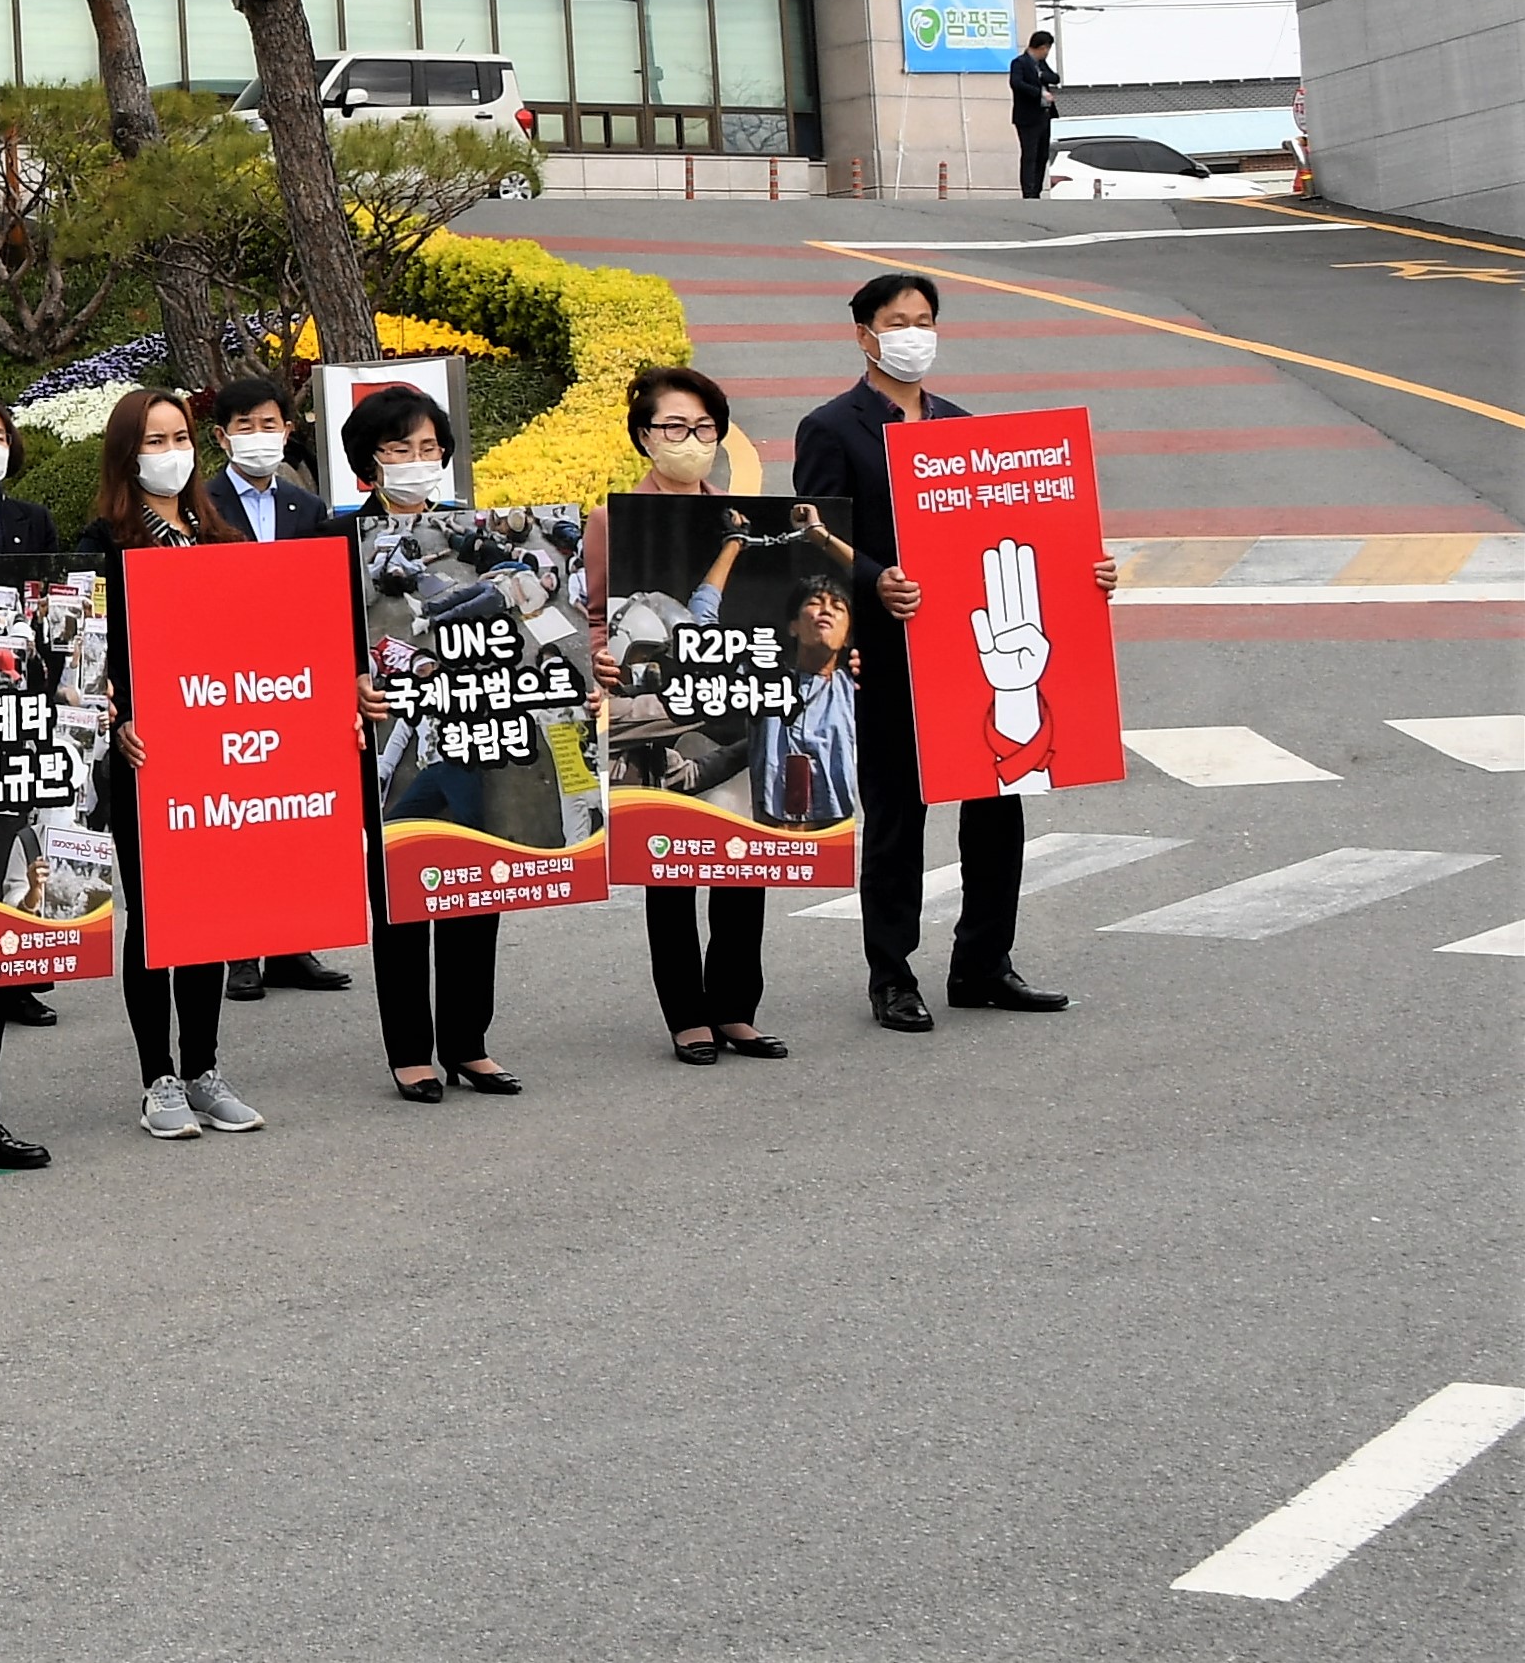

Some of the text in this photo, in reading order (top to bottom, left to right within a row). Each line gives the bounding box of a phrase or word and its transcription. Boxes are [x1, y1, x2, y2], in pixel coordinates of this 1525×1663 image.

[945, 10, 1010, 37] 함평군
[913, 438, 1072, 479] Save Myanmar!
[917, 476, 1075, 513] 미얀마 쿠테타 반대!
[439, 619, 516, 660] UN은
[678, 627, 783, 669] R2P를
[179, 667, 312, 709] We Need
[385, 666, 579, 719] 국제규범으로
[662, 673, 798, 717] 실행하라
[221, 729, 280, 765] R2P
[441, 716, 531, 764] 확립된
[168, 790, 337, 830] in Myanmar
[673, 839, 818, 856] 함평군 함평군의회
[443, 857, 574, 885] 함평군 함평군의회
[652, 864, 814, 880] 동남아 결혼이주여성 일동
[425, 894, 464, 912] 동남아
[546, 882, 571, 898] 일동
[20, 929, 81, 949] 함평군의회
[53, 955, 77, 973] 일동
